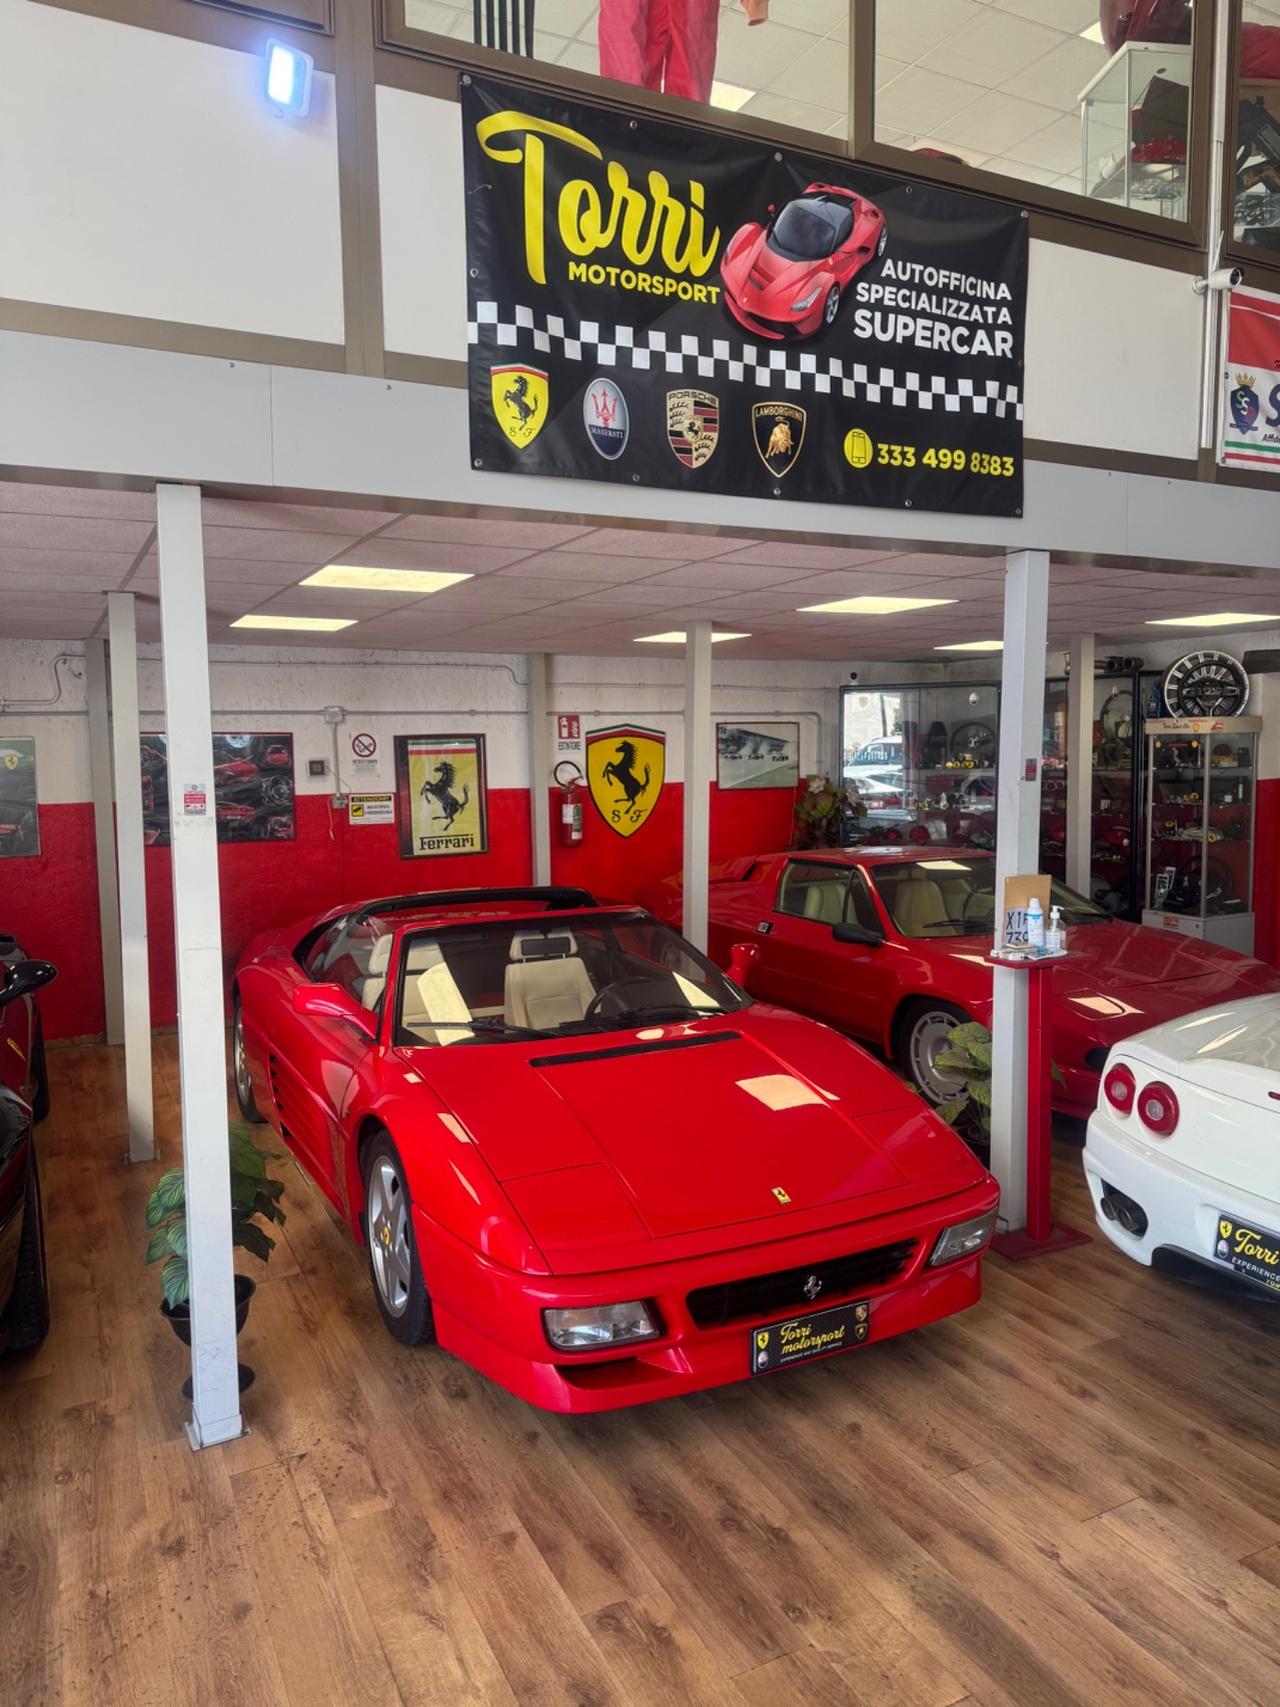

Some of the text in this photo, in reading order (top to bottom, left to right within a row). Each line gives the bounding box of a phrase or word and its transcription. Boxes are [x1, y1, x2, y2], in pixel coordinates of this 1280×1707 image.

[477, 110, 720, 284] Torri
[568, 261, 720, 304] MOTORSPORT
[881, 258, 1012, 301] AUTOFFICINA
[856, 282, 1013, 325] SPECIALIZZATA
[853, 308, 1014, 358] SUPERCAR
[668, 390, 718, 406] PORSCHE
[755, 406, 803, 421] LAMBORGHINI
[590, 427, 625, 439] MASERATI
[877, 443, 1015, 477] 333 499 8383
[419, 833, 474, 850] Ferrari
[1234, 1228, 1280, 1265] Torri
[1231, 1256, 1280, 1282] EXPERIENCE
[780, 1322, 812, 1343] Torri
[781, 1324, 845, 1354] motorsport
